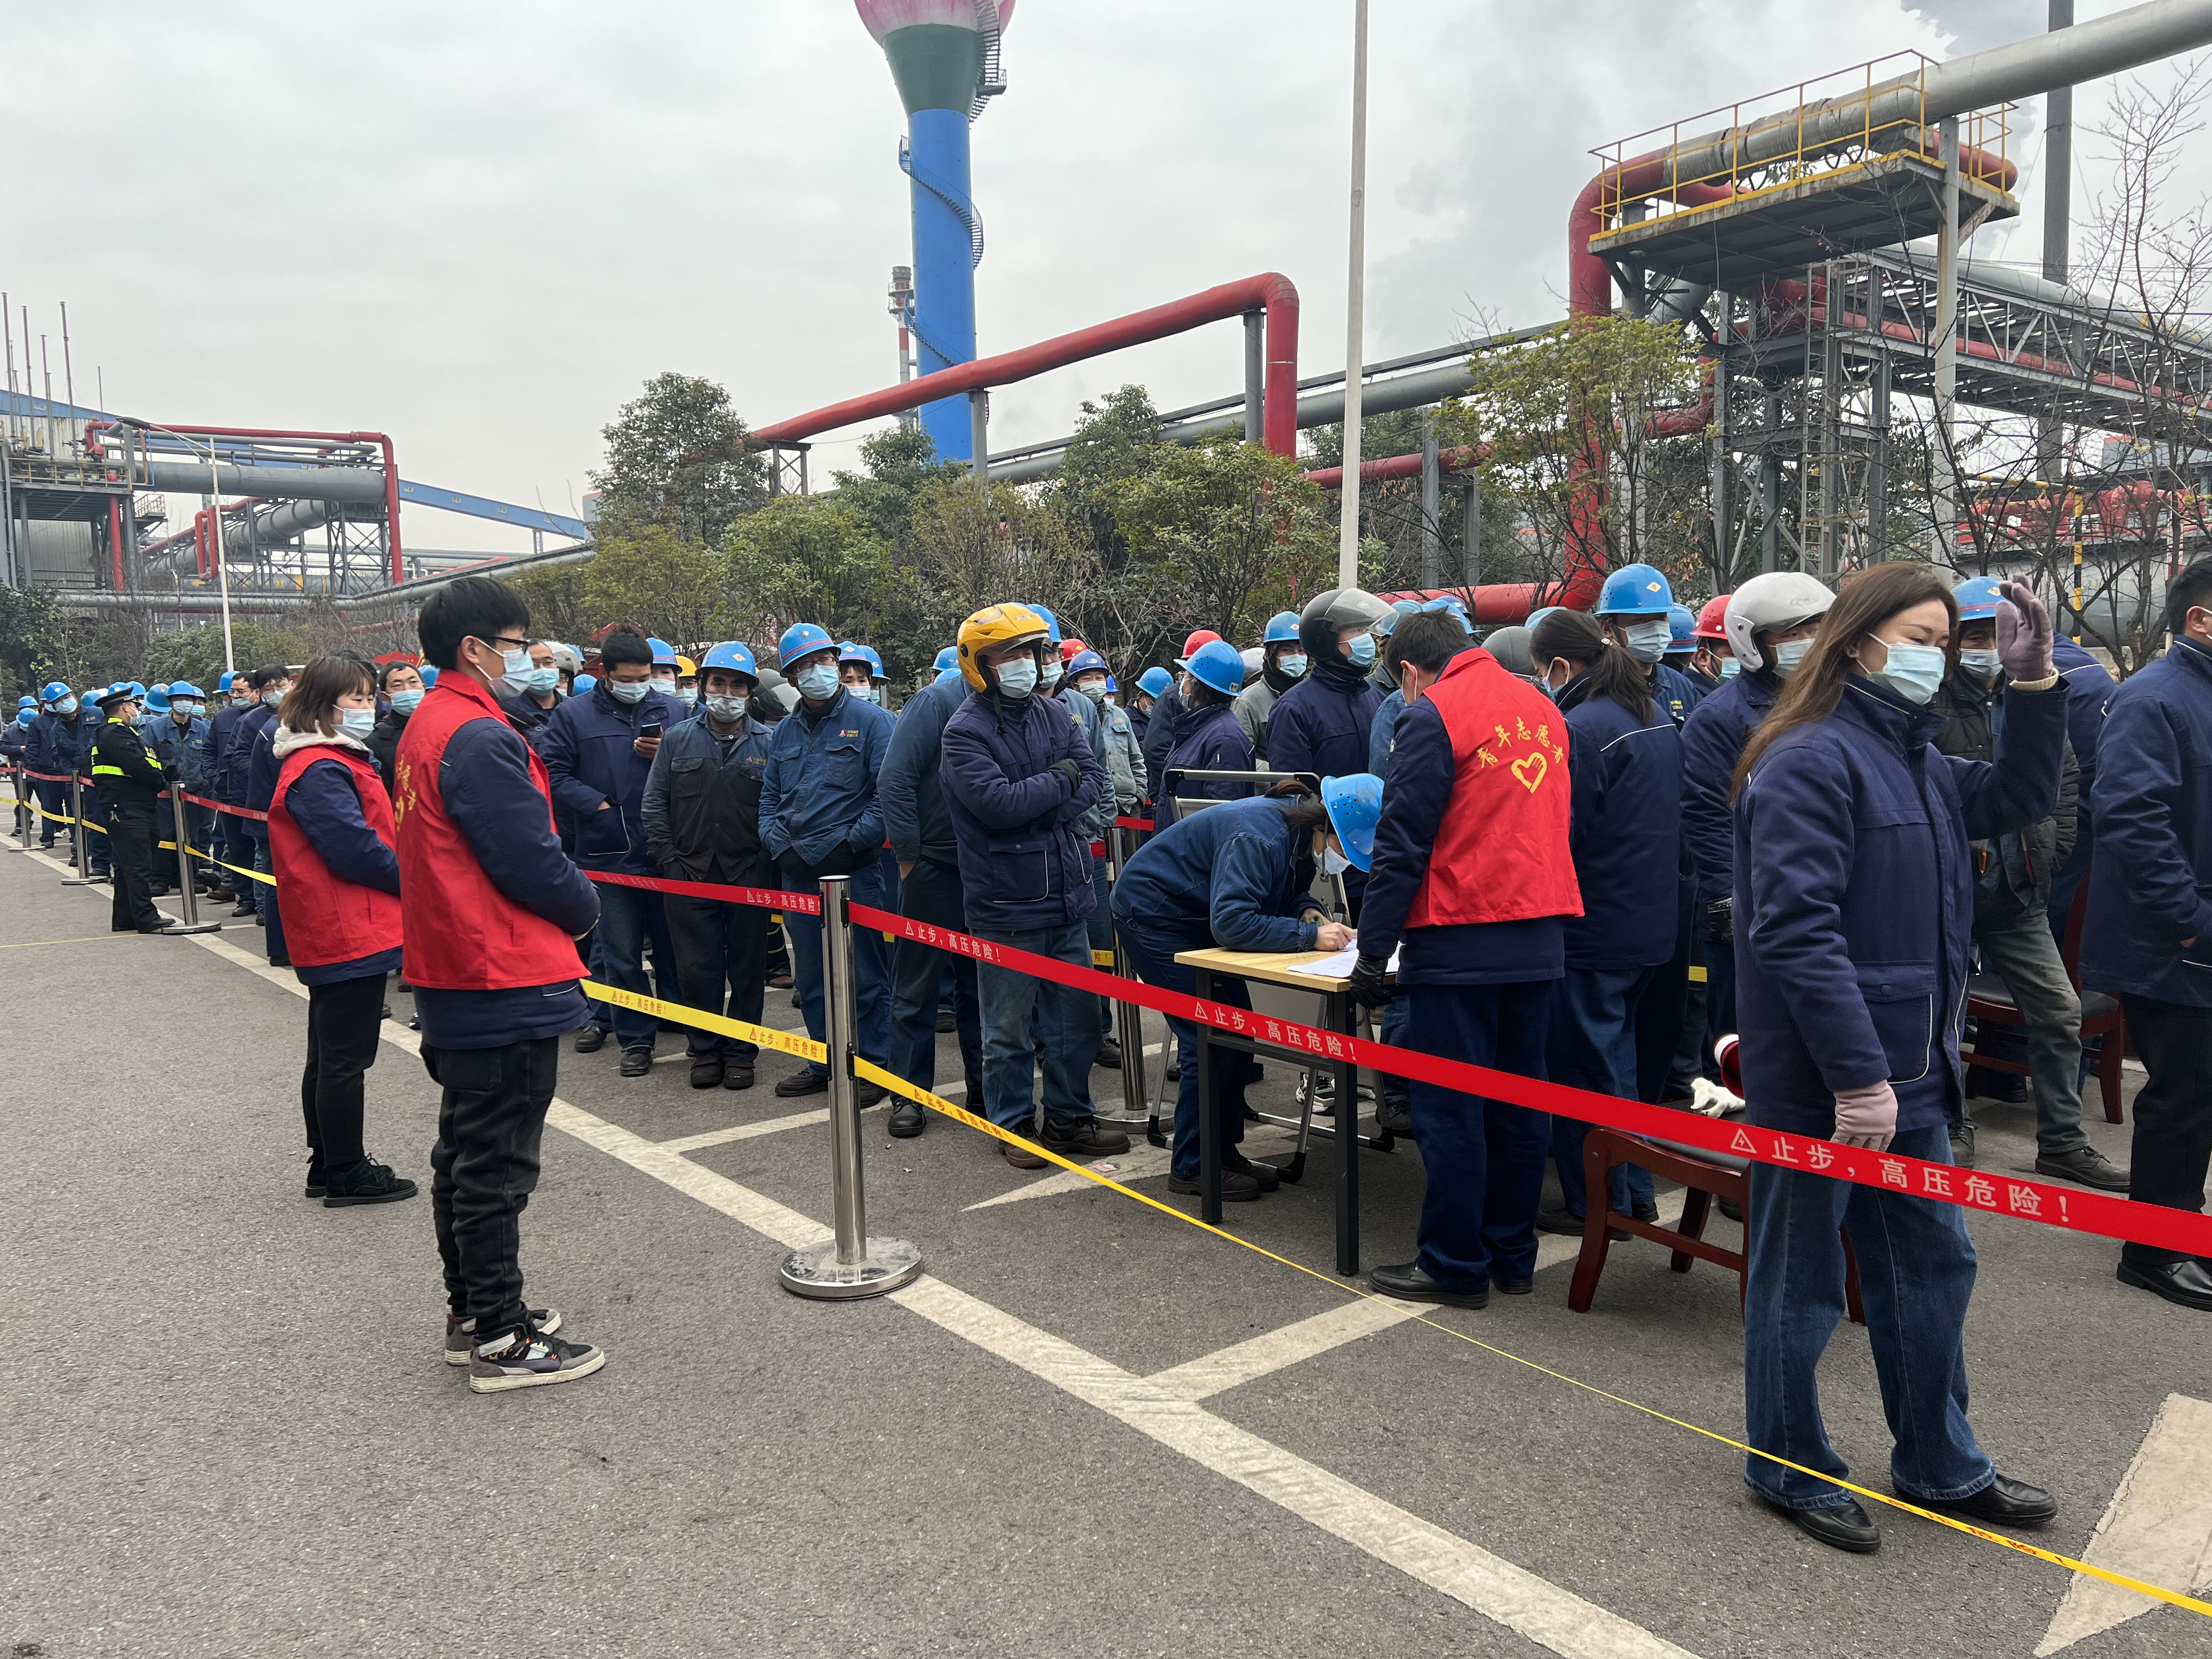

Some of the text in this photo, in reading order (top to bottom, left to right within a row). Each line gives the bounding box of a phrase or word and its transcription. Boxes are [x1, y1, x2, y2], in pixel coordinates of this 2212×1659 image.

[1771, 1136, 2068, 1223] 止步，高压危险！
